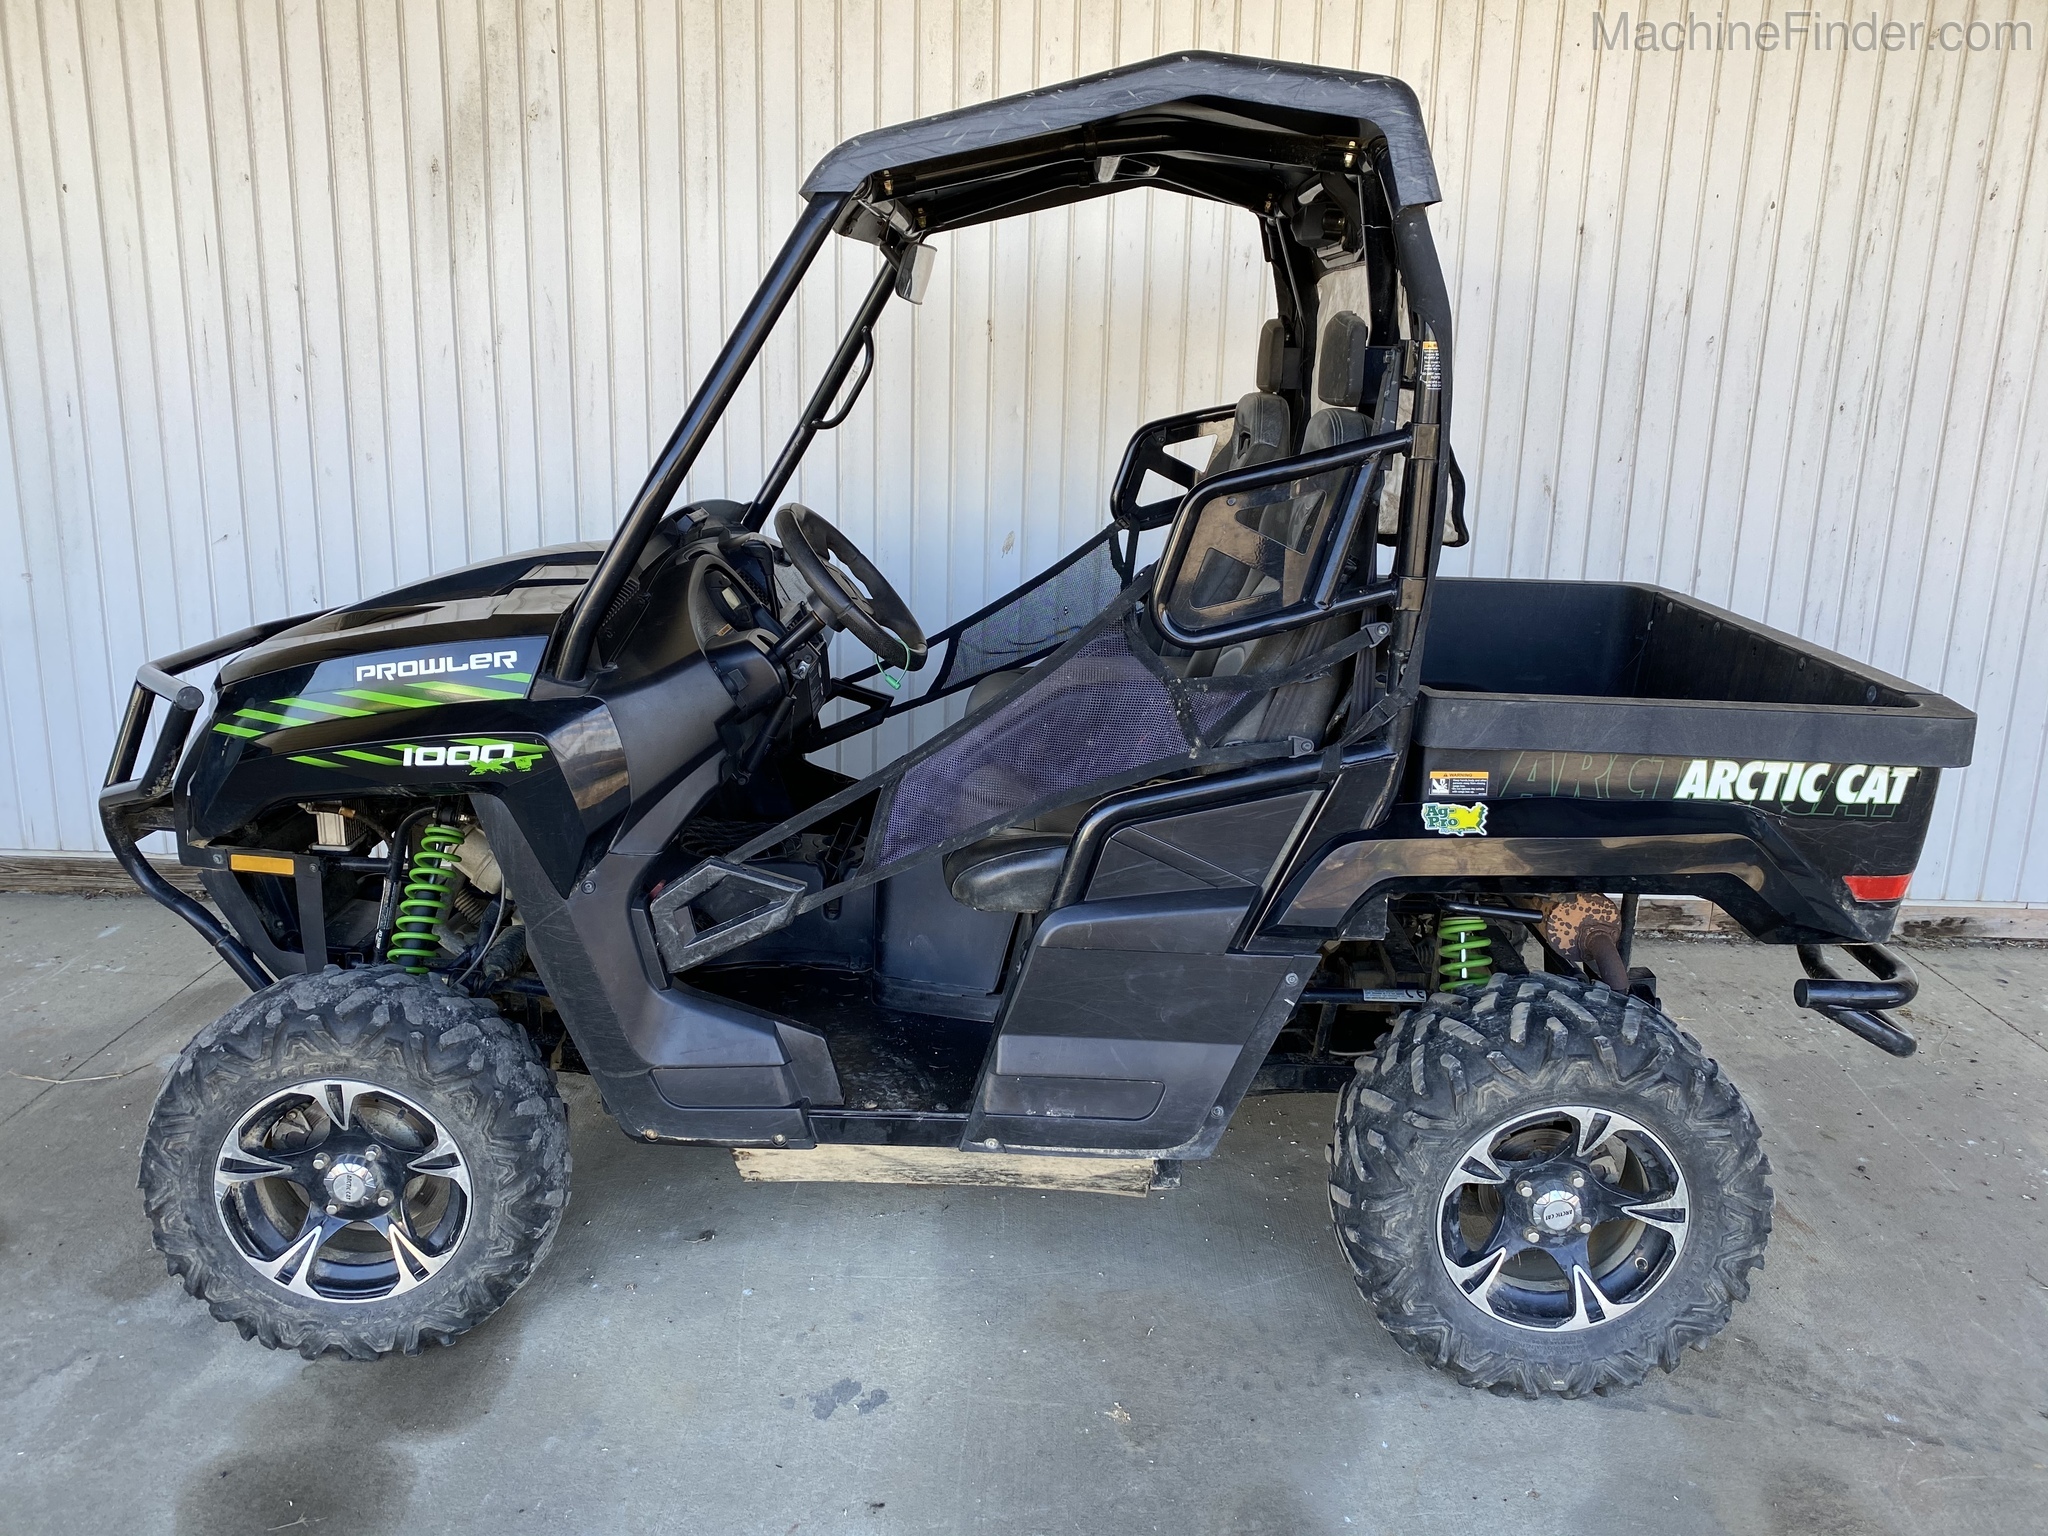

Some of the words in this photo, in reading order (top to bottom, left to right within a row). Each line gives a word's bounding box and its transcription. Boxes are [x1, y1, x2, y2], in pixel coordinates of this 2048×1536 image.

[356, 650, 518, 682] PROWLER
[403, 743, 515, 767] 1000
[467, 753, 543, 776] XT
[1673, 759, 1833, 803] ARCTIC
[1835, 763, 1919, 805] CAT
[1426, 805, 1456, 818] Ag-
[1428, 816, 1458, 827] Pro
